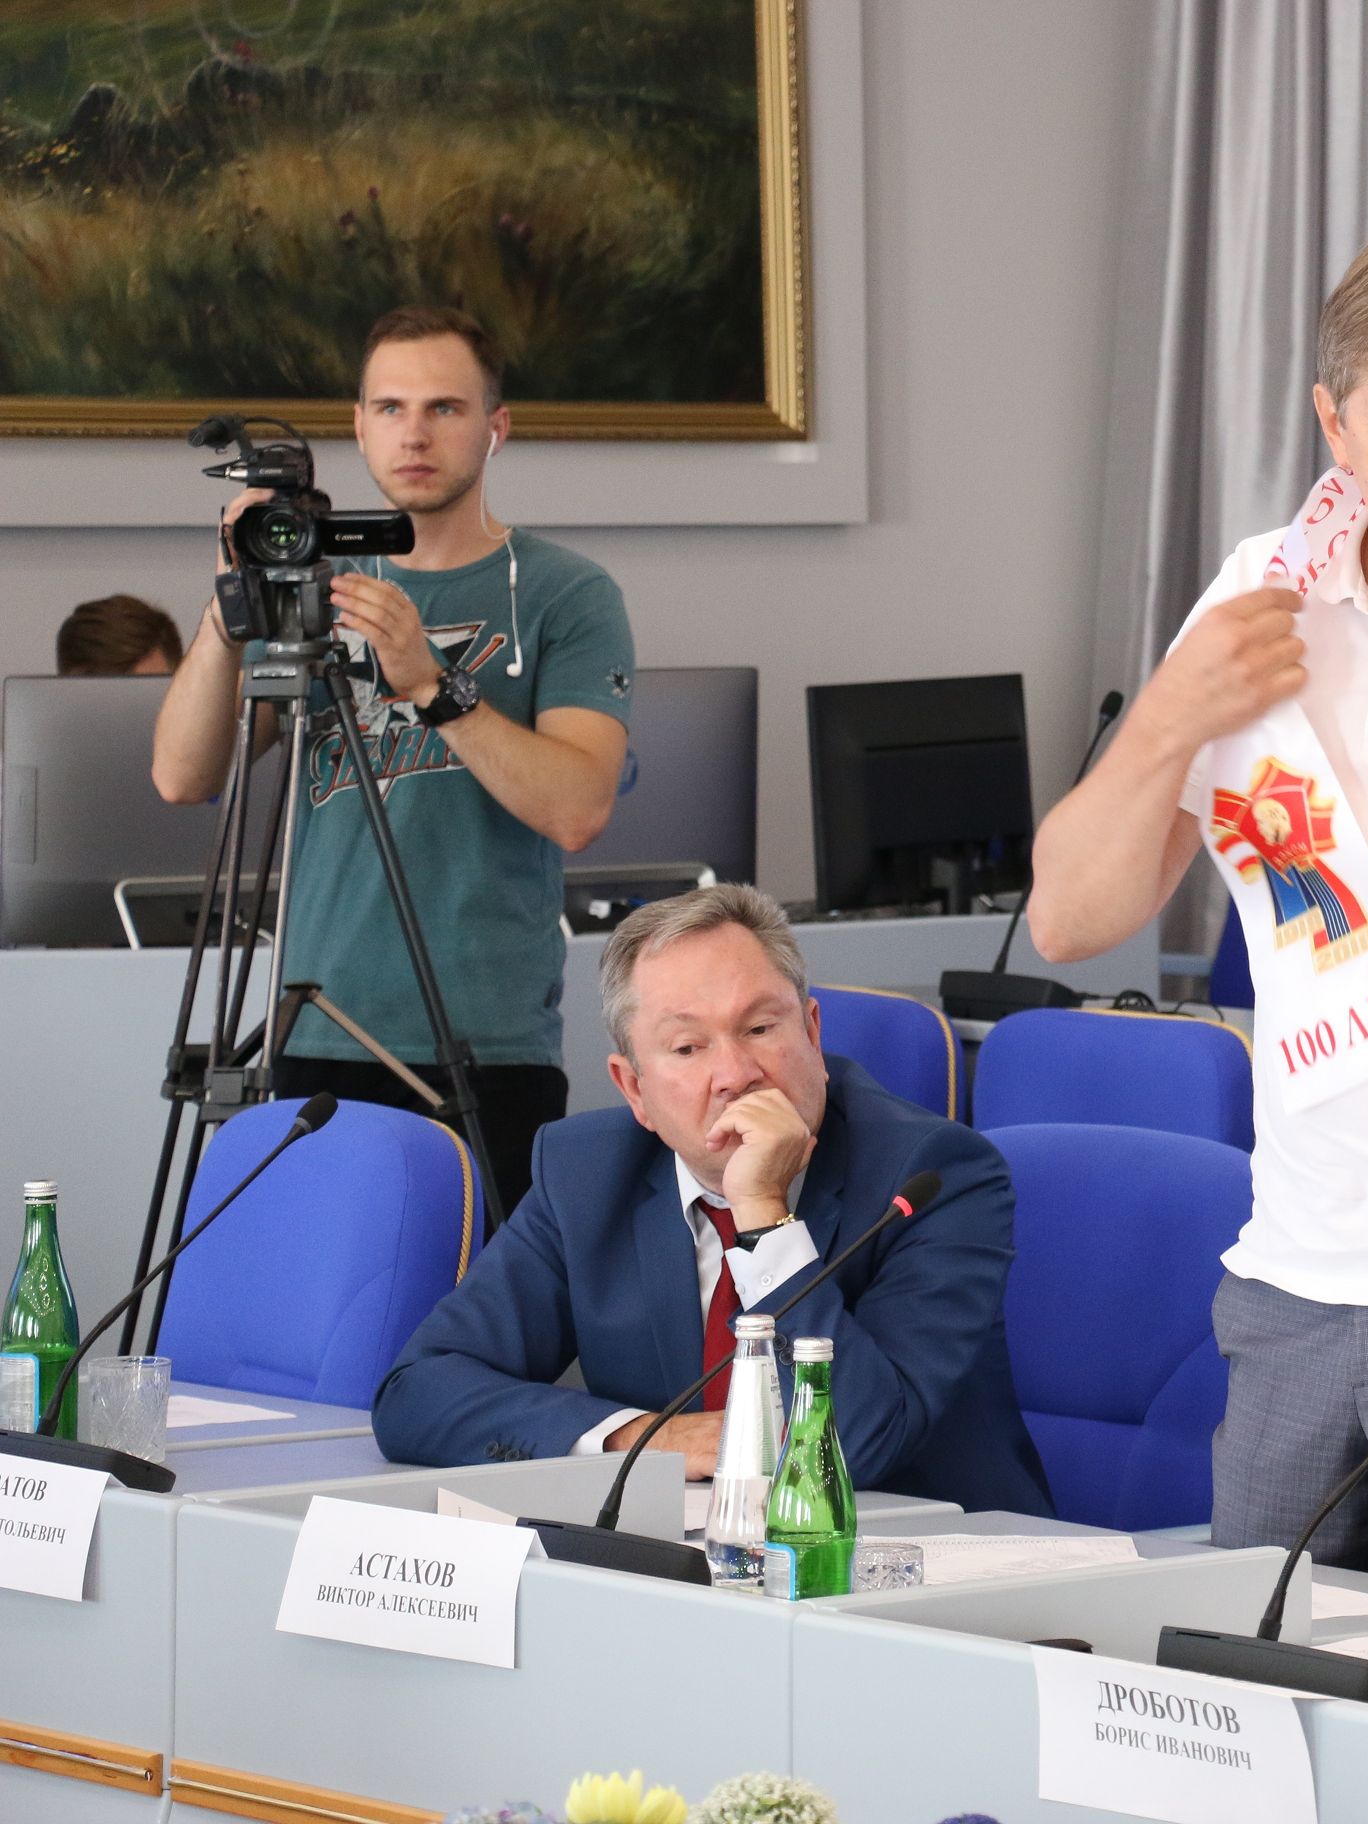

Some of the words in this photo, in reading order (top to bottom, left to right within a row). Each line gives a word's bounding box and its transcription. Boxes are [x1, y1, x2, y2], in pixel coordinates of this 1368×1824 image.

[1279, 1018, 1337, 1076] 100
[0, 1475, 47, 1501] АТОВ
[350, 1552, 456, 1588] АСТАХОВ
[316, 1584, 375, 1608] ВИКТОР
[376, 1594, 478, 1622] АЛЕКСЕЕВИЧ
[1098, 1680, 1241, 1734] ДРОБОТОВ
[1095, 1722, 1152, 1751] БОРИС
[1156, 1734, 1252, 1770] ИВАНОВИЧ
